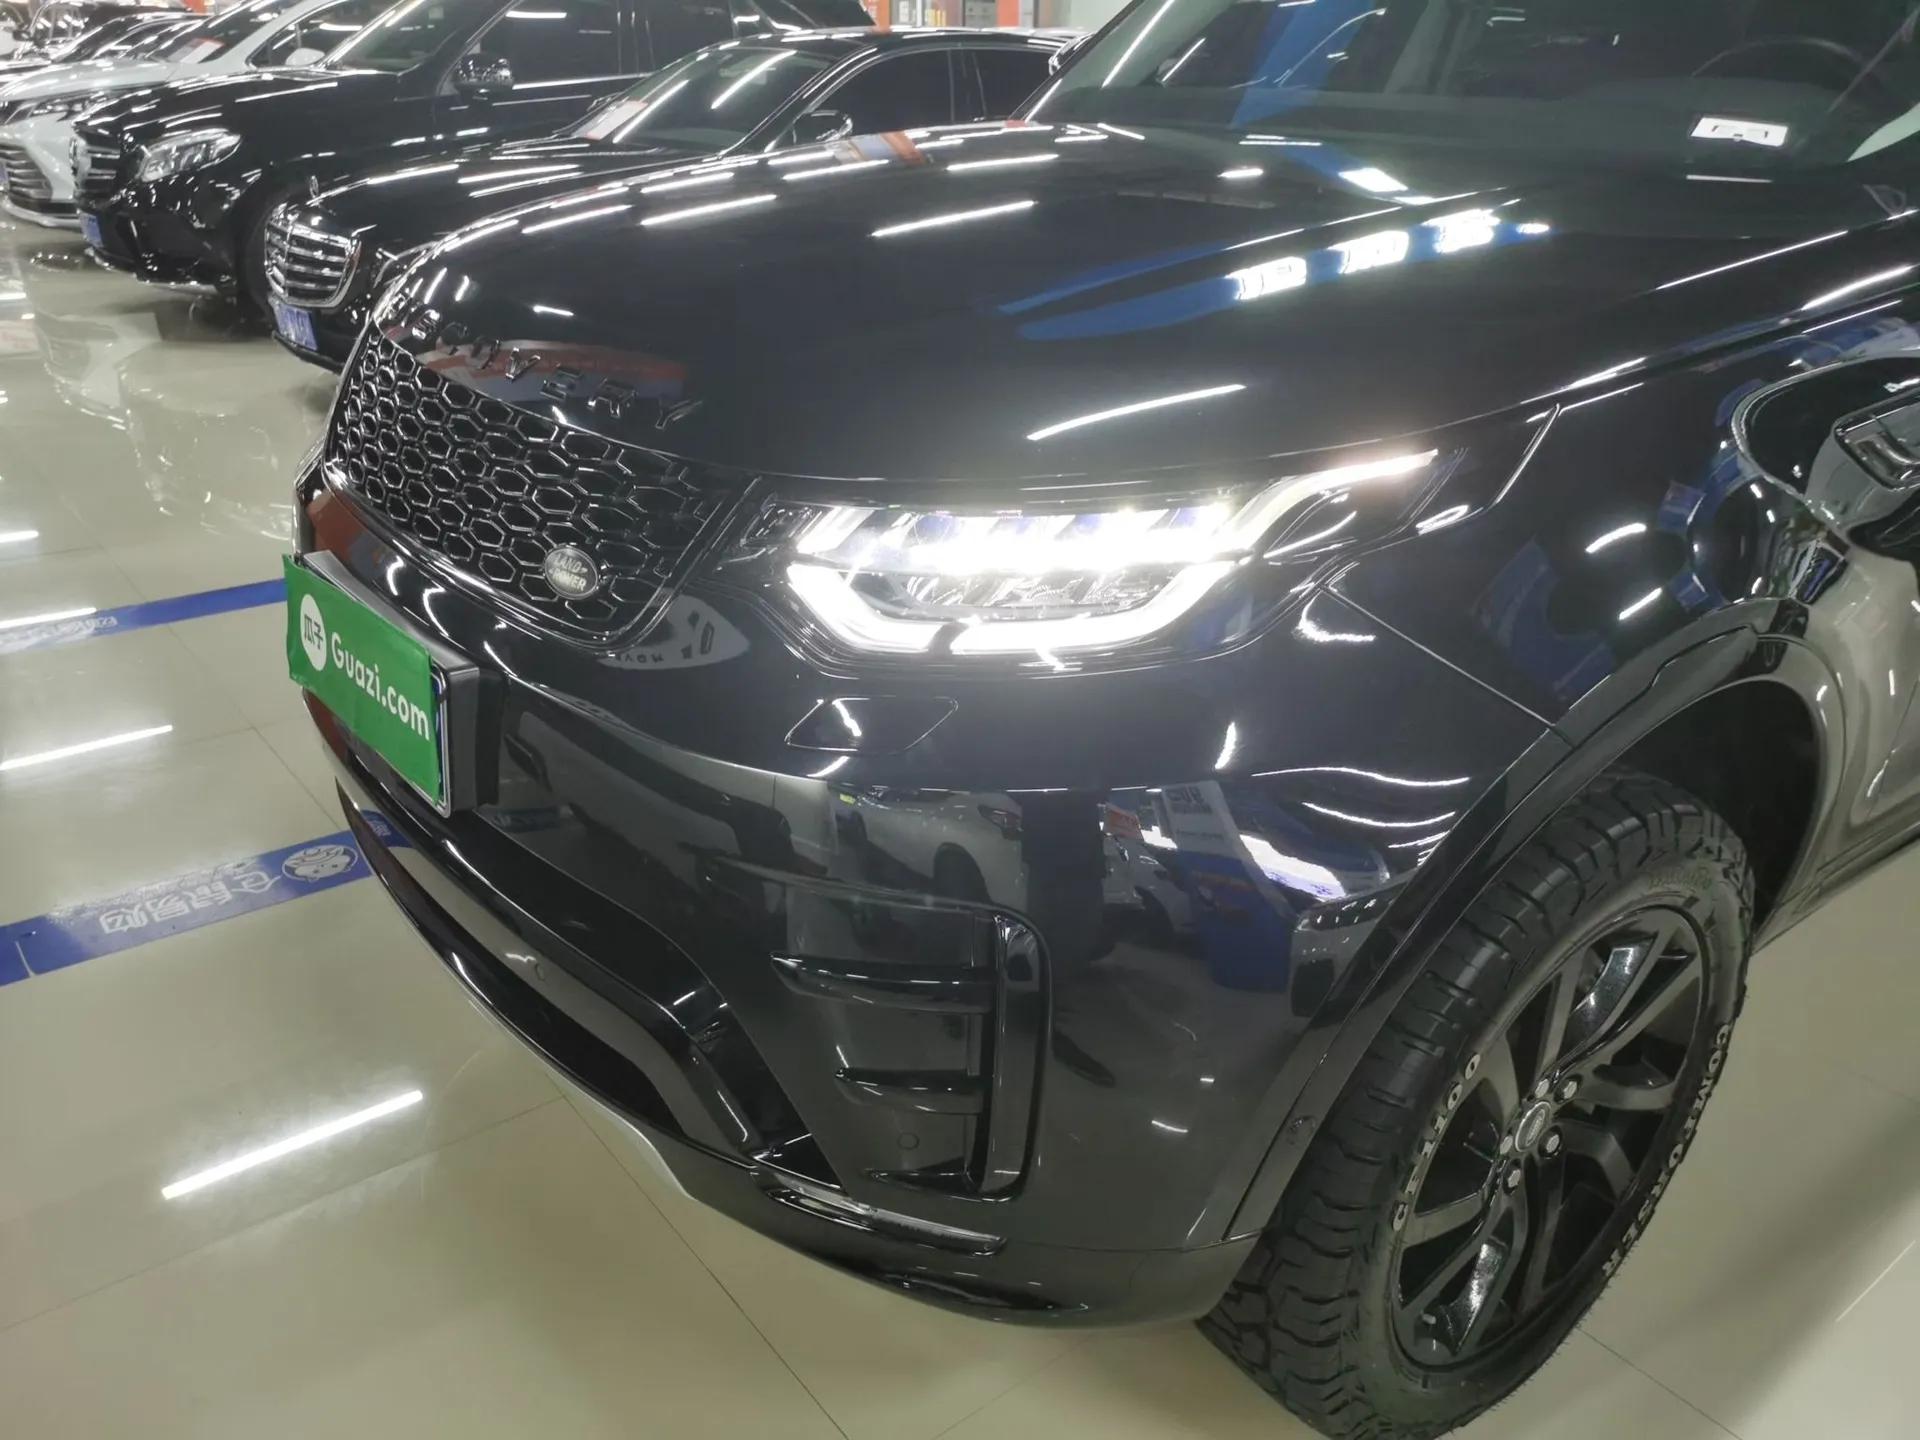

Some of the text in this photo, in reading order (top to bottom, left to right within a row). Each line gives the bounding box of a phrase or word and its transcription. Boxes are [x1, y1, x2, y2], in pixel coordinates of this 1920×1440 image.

[304, 614, 324, 650] 瓜子
[331, 631, 430, 741] Guazi.com
[100, 870, 282, 934] 仓鼠易购
[1392, 1053, 1481, 1232] CF1100
[1602, 1023, 1730, 1277] COMFORSER
